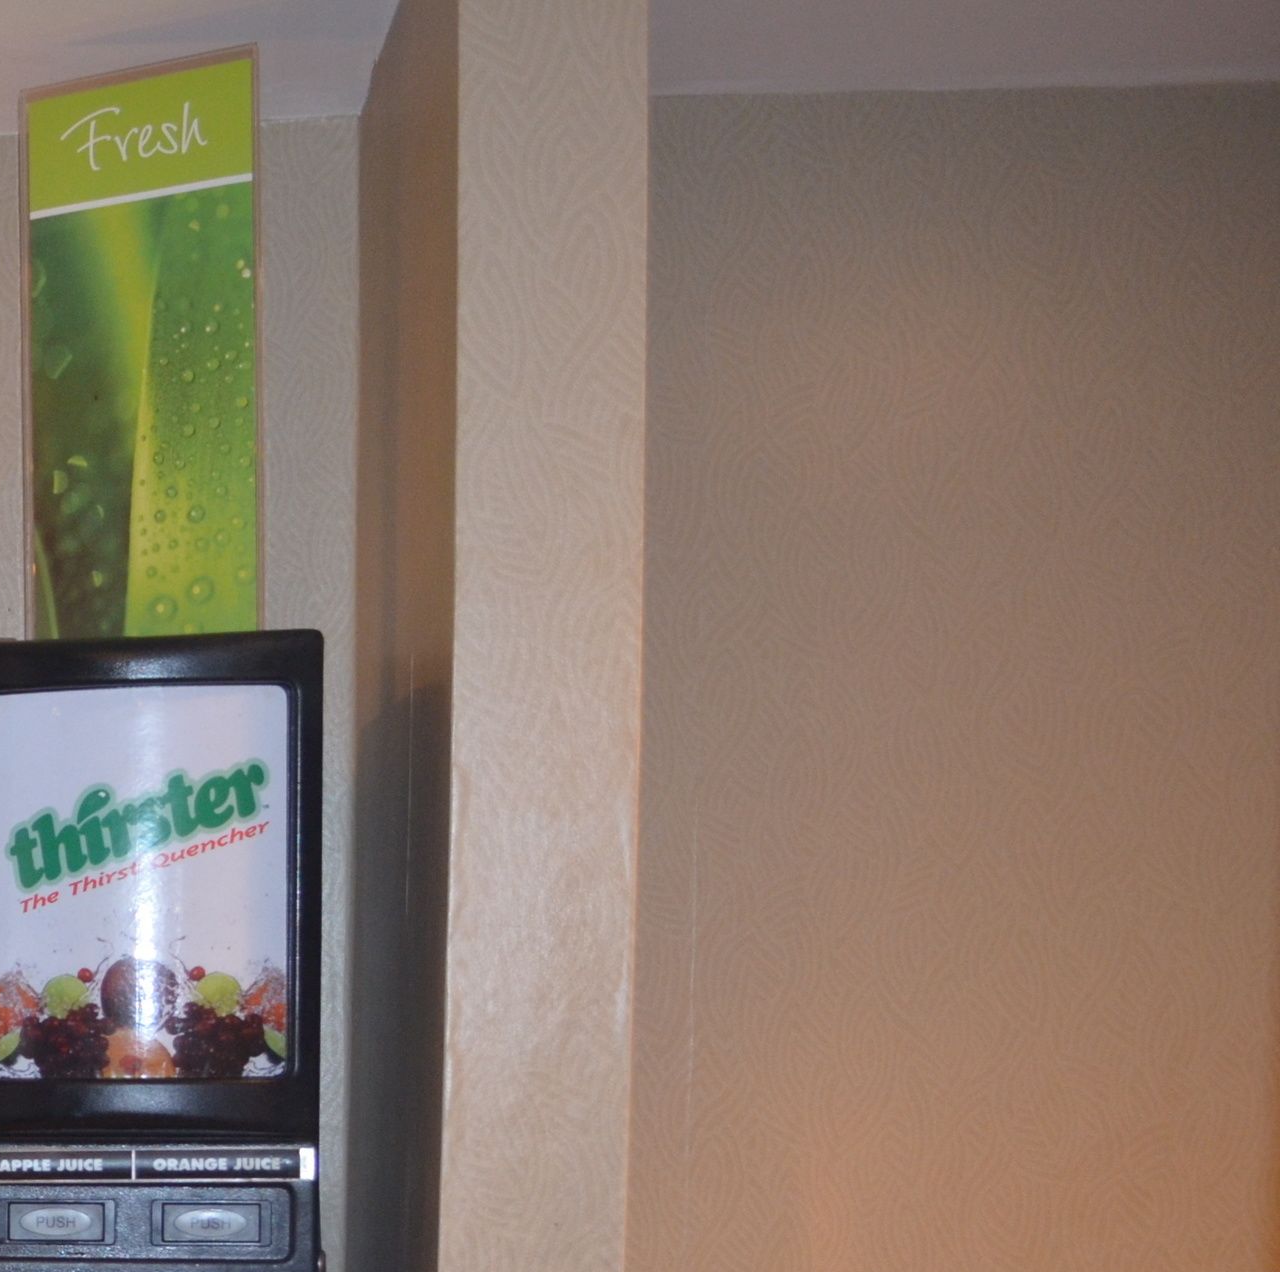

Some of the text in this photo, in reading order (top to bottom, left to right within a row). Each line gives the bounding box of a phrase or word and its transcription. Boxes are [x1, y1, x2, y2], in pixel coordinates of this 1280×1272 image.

[60, 102, 207, 172] Fresh
[8, 762, 265, 890] thirster
[20, 819, 271, 914] The Thirst Quencher
[56, 1158, 104, 1172] JUICE
[152, 1157, 281, 1171] ORANGE JUICE
[35, 1217, 77, 1229] PUSH
[190, 1217, 232, 1230] PUSH
